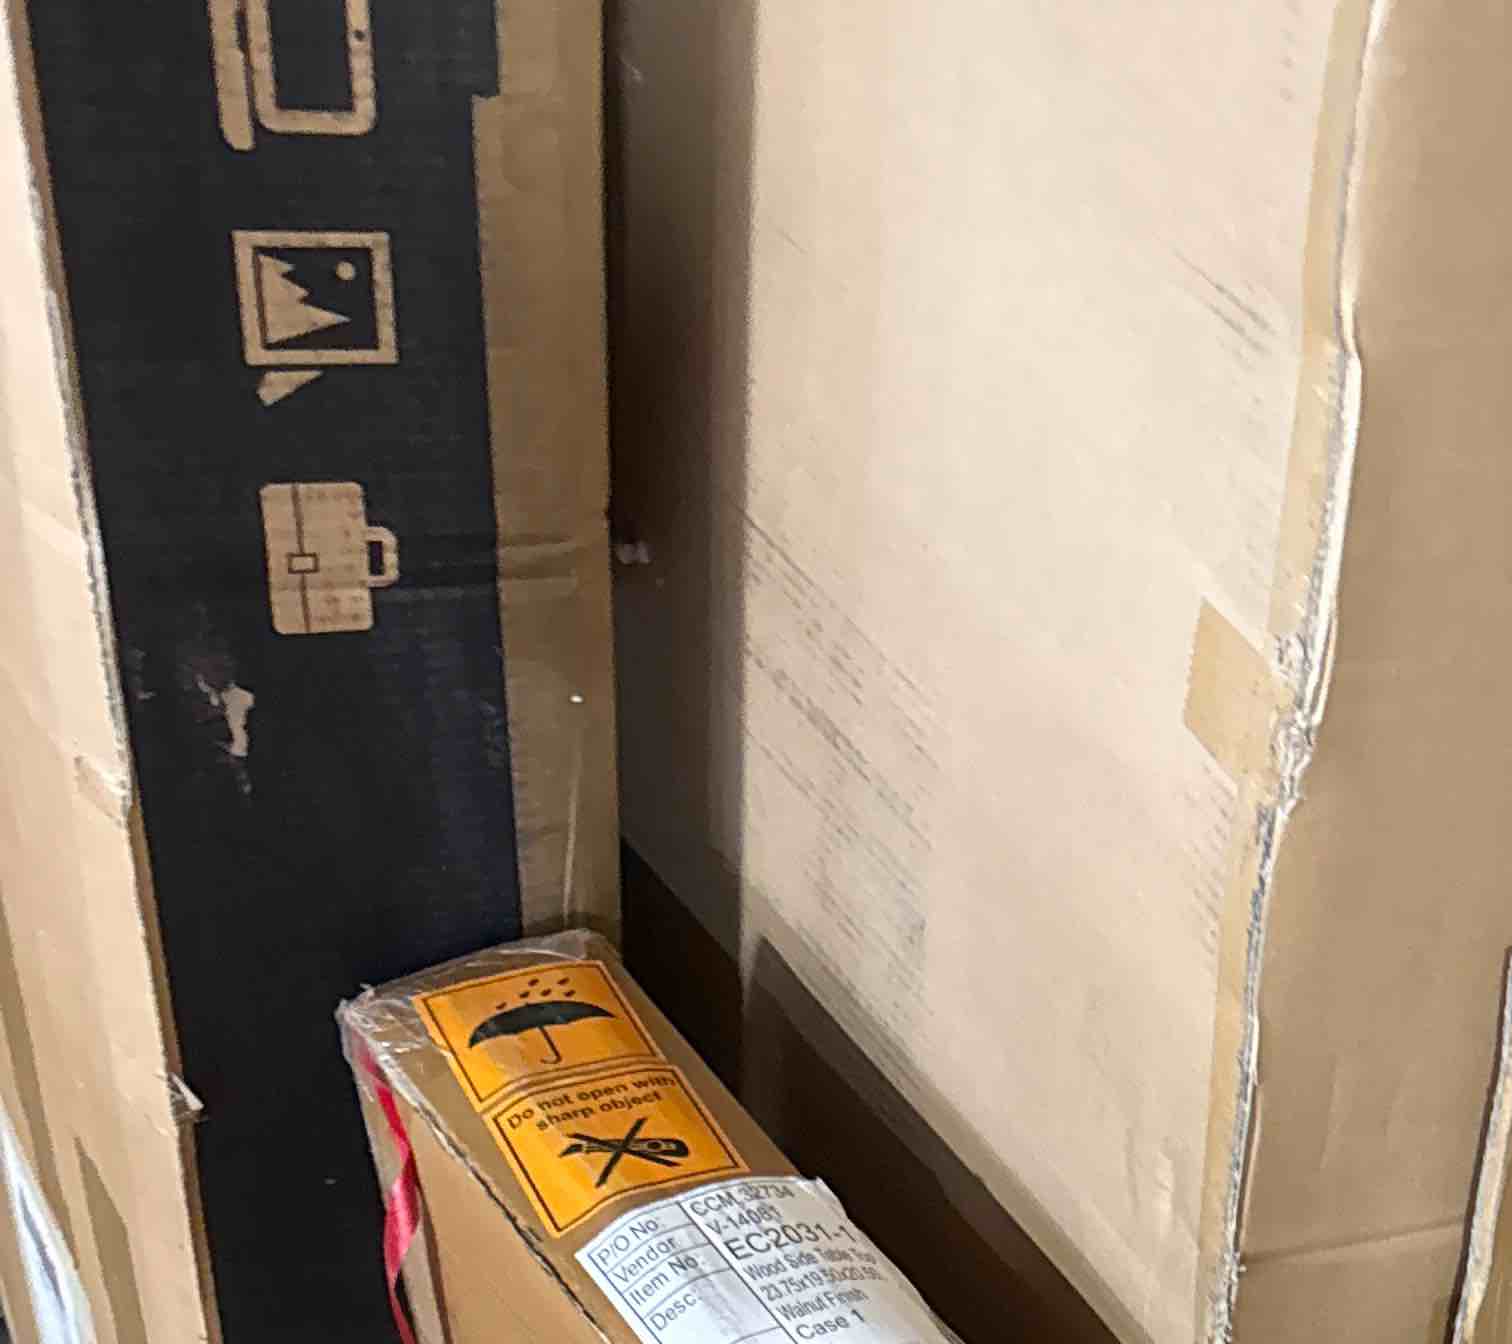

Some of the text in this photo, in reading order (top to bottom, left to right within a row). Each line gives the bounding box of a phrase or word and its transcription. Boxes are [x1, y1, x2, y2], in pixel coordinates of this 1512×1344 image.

[507, 1074, 677, 1130] Do not open with
[536, 1090, 663, 1131] sharp object
[628, 1271, 671, 1306] Item
[724, 1222, 858, 1261] EC2031-1
[742, 1256, 788, 1282] Wood
[775, 1294, 828, 1322] Walnut
[795, 1309, 866, 1341] Case 1
